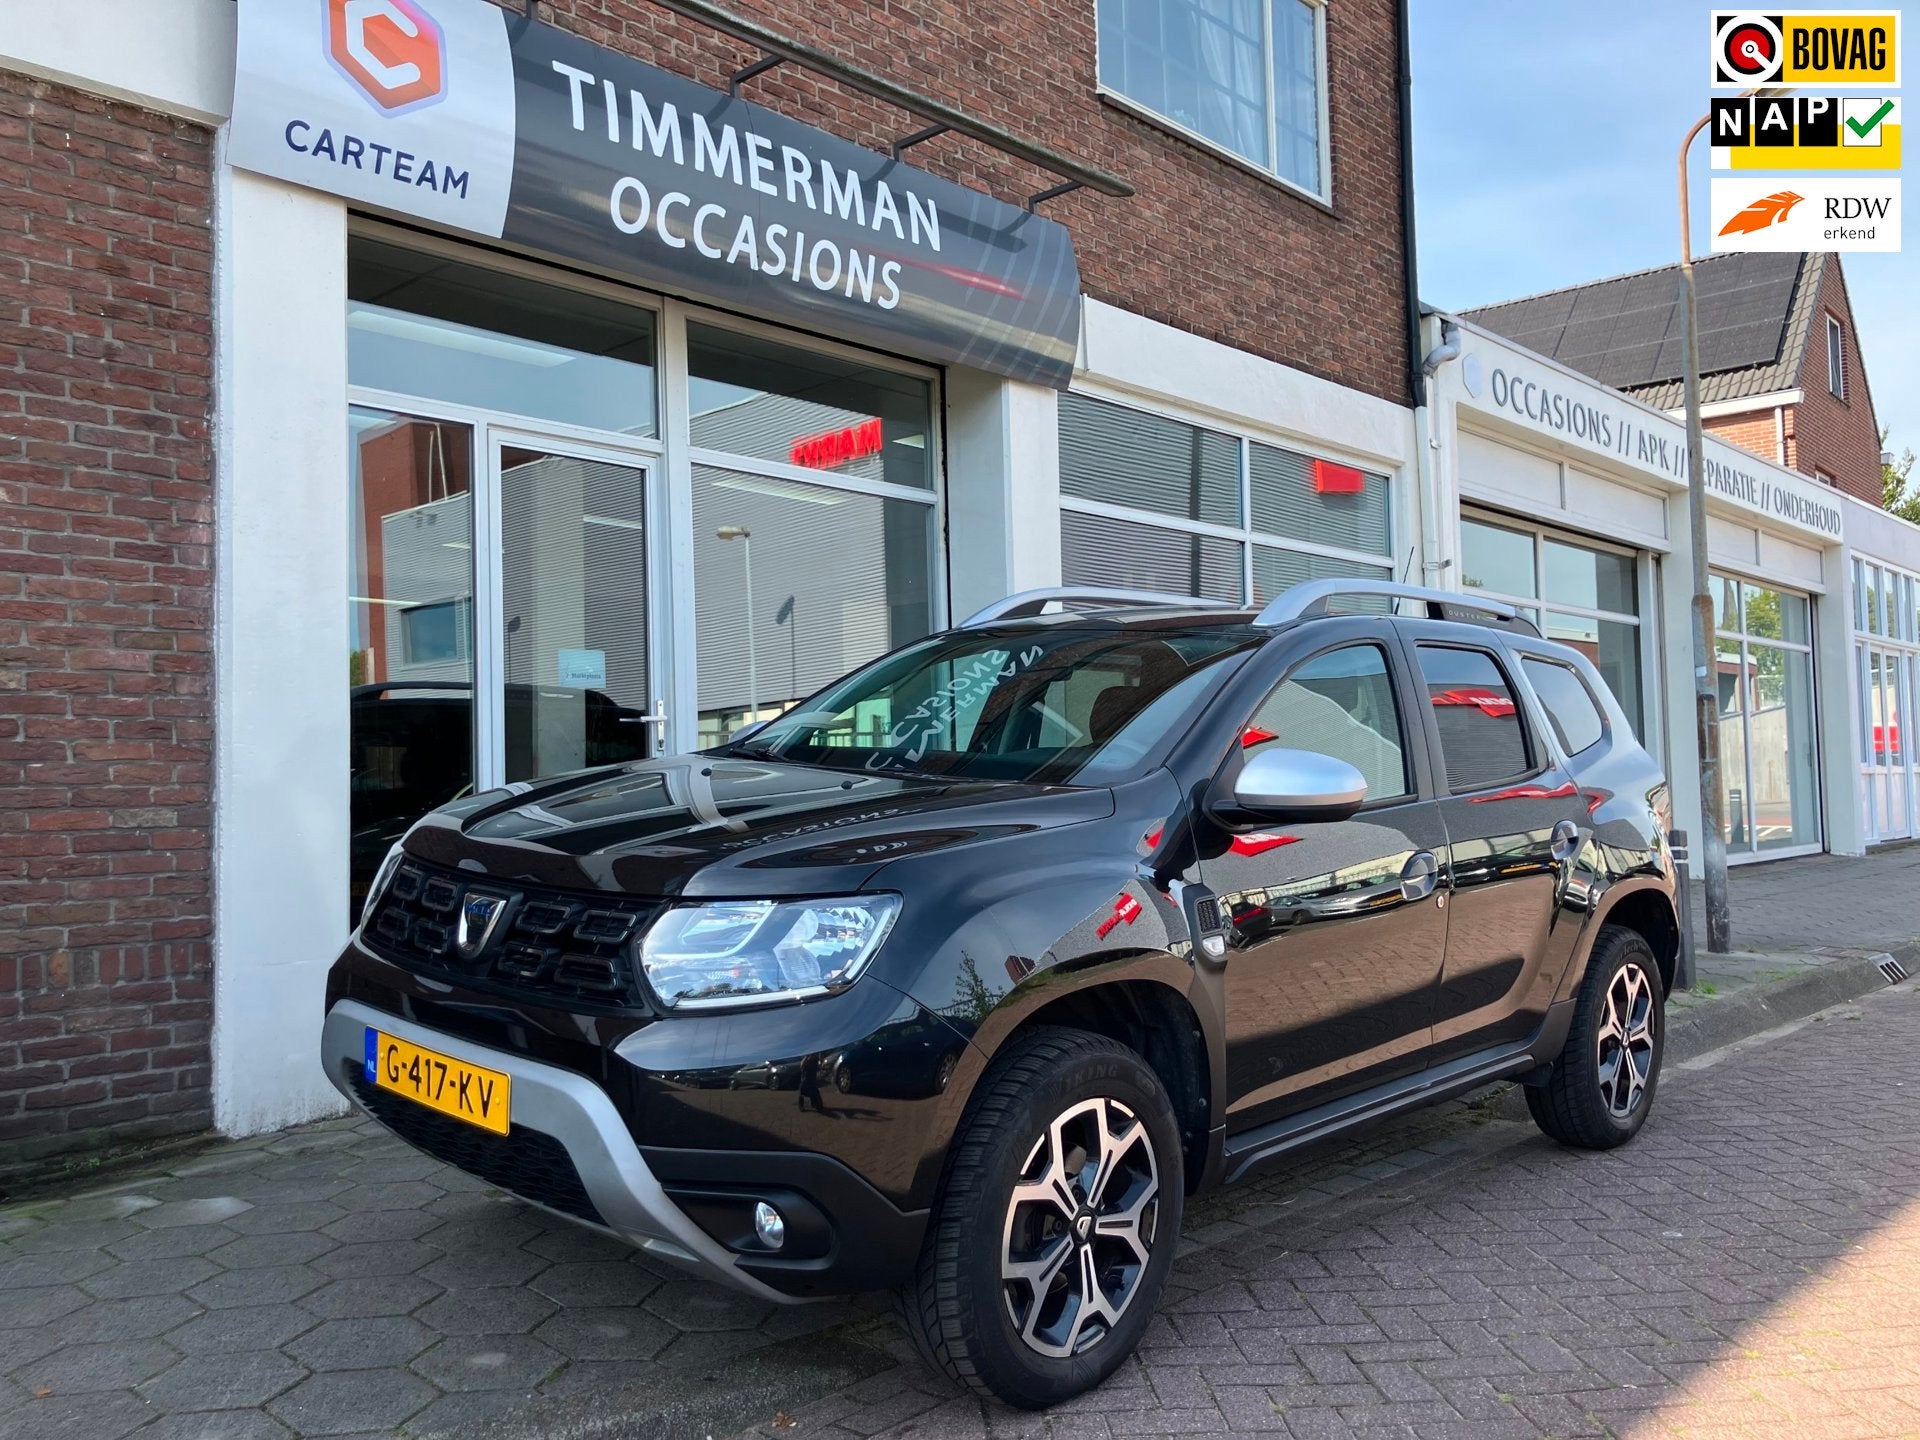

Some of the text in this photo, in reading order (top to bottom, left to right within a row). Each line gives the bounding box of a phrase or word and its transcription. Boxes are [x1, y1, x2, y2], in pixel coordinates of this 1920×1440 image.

[285, 119, 470, 200] CARTEAM
[552, 60, 942, 252] TIMMERMAN
[610, 176, 902, 310] OCCASIONS
[1492, 368, 1612, 447] OCCASIONS
[1638, 429, 1671, 471] APK
[1702, 456, 1758, 505] PARATIE
[1774, 486, 1841, 535] ONDERHOUD
[367, 1059, 376, 1073] NL
[387, 1043, 494, 1119] G-417-KV
